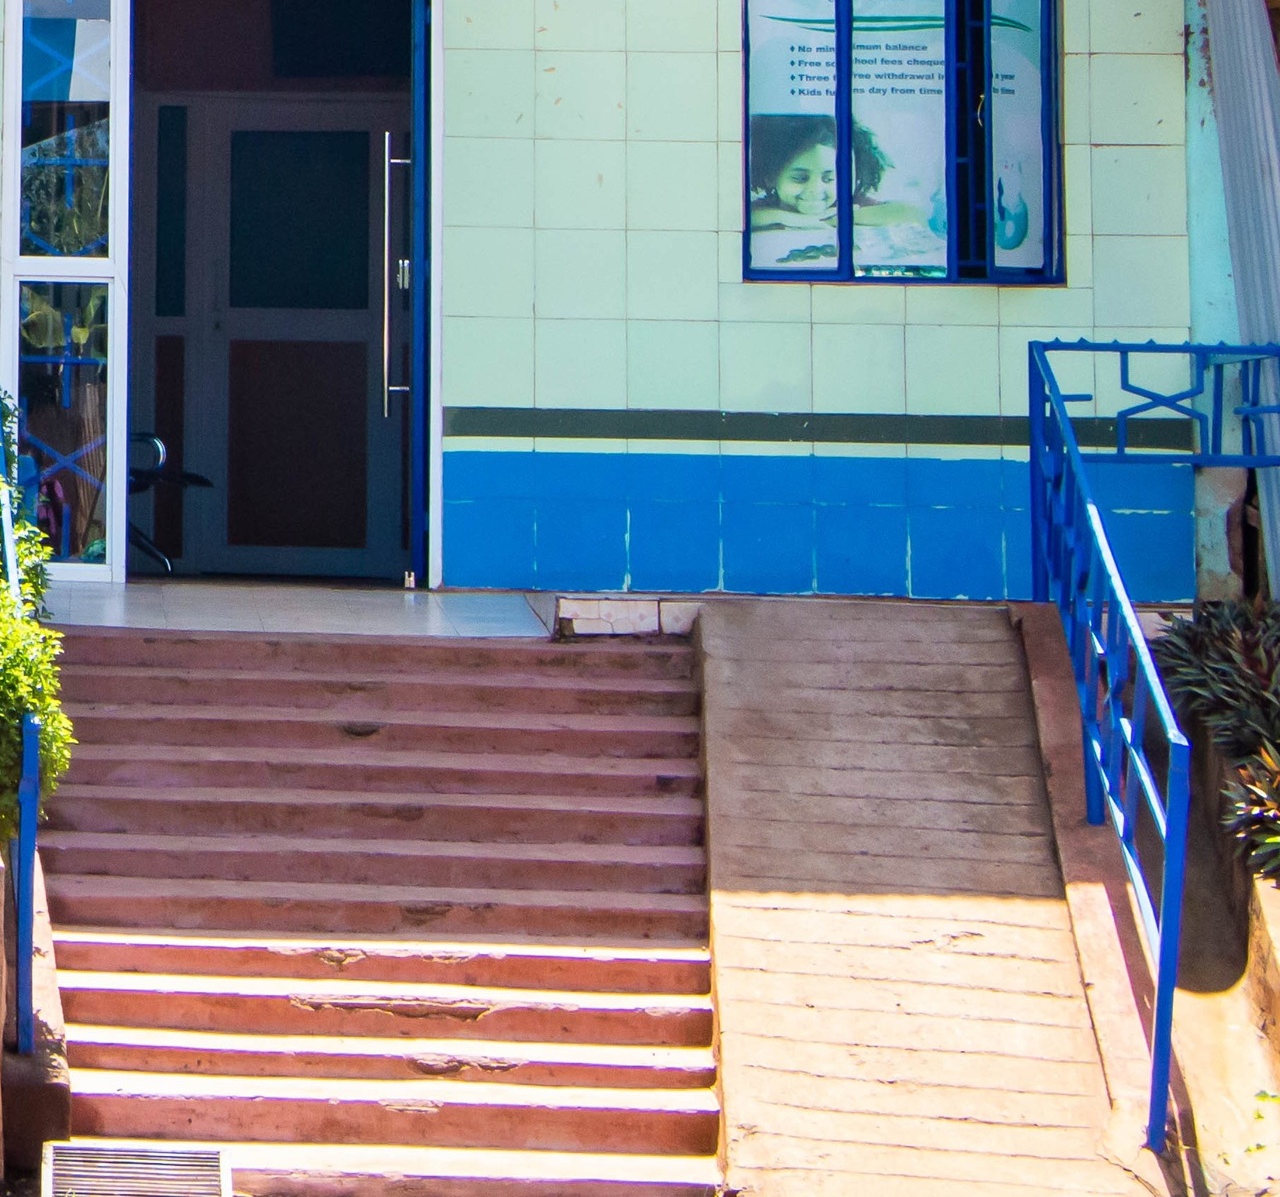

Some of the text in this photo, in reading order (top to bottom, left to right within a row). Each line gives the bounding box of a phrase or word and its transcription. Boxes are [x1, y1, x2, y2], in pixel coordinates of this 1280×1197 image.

[798, 45, 812, 53] No
[885, 43, 928, 51] balance
[798, 59, 822, 67] Free
[880, 58, 903, 66] fees
[798, 74, 830, 82] Three
[875, 72, 934, 80] withdrawal
[798, 88, 822, 96] Kids
[869, 86, 887, 95] day
[891, 87, 916, 95] from
[919, 87, 943, 95] time
